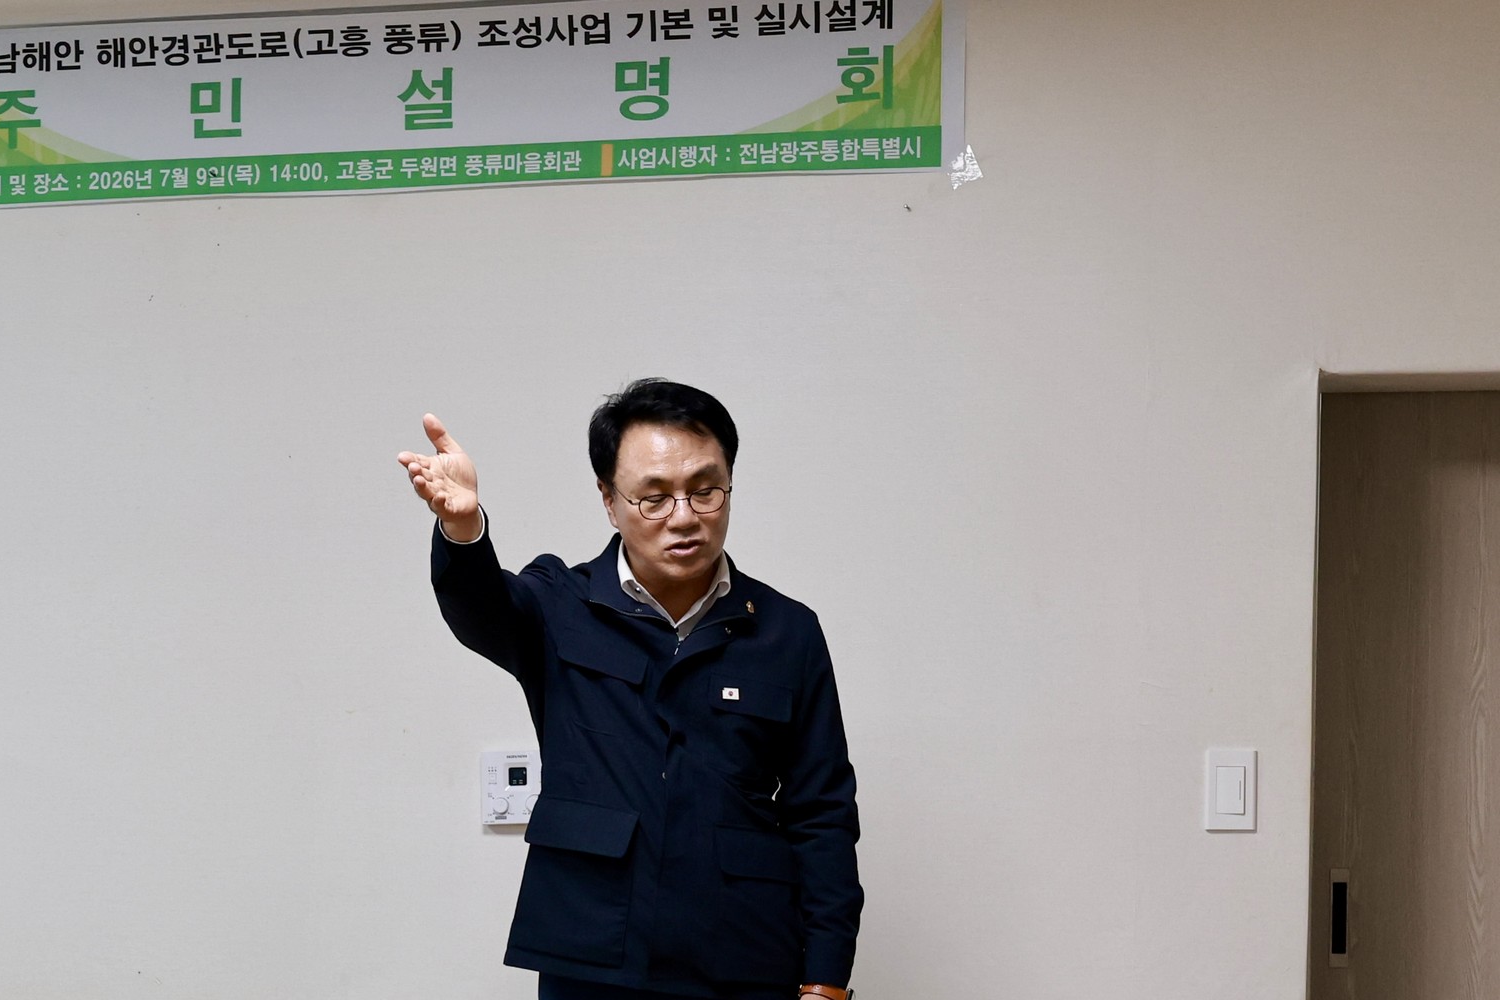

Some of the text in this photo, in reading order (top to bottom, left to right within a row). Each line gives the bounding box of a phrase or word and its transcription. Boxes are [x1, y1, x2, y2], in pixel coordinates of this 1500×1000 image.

[96, 25, 372, 69] 해안경관도로(고흥
[383, 18, 462, 56] 풍류)
[477, 12, 611, 49] 조성사업
[627, 7, 694, 43] 기본
[707, 3, 740, 38] 및
[754, 0, 895, 36] 실시설계
[8, 173, 26, 196] 및
[33, 170, 70, 194] 장소
[88, 166, 153, 191] 2026년
[159, 165, 190, 189] 7월
[196, 162, 261, 188] 9일(목)
[270, 160, 330, 185] 14:00,
[335, 157, 395, 182] 고흥군
[400, 154, 458, 180] 두원면
[464, 149, 582, 179] 풍류마을회관
[618, 143, 718, 171] 사업시행자
[738, 135, 924, 167] 전남광주통합특별시
